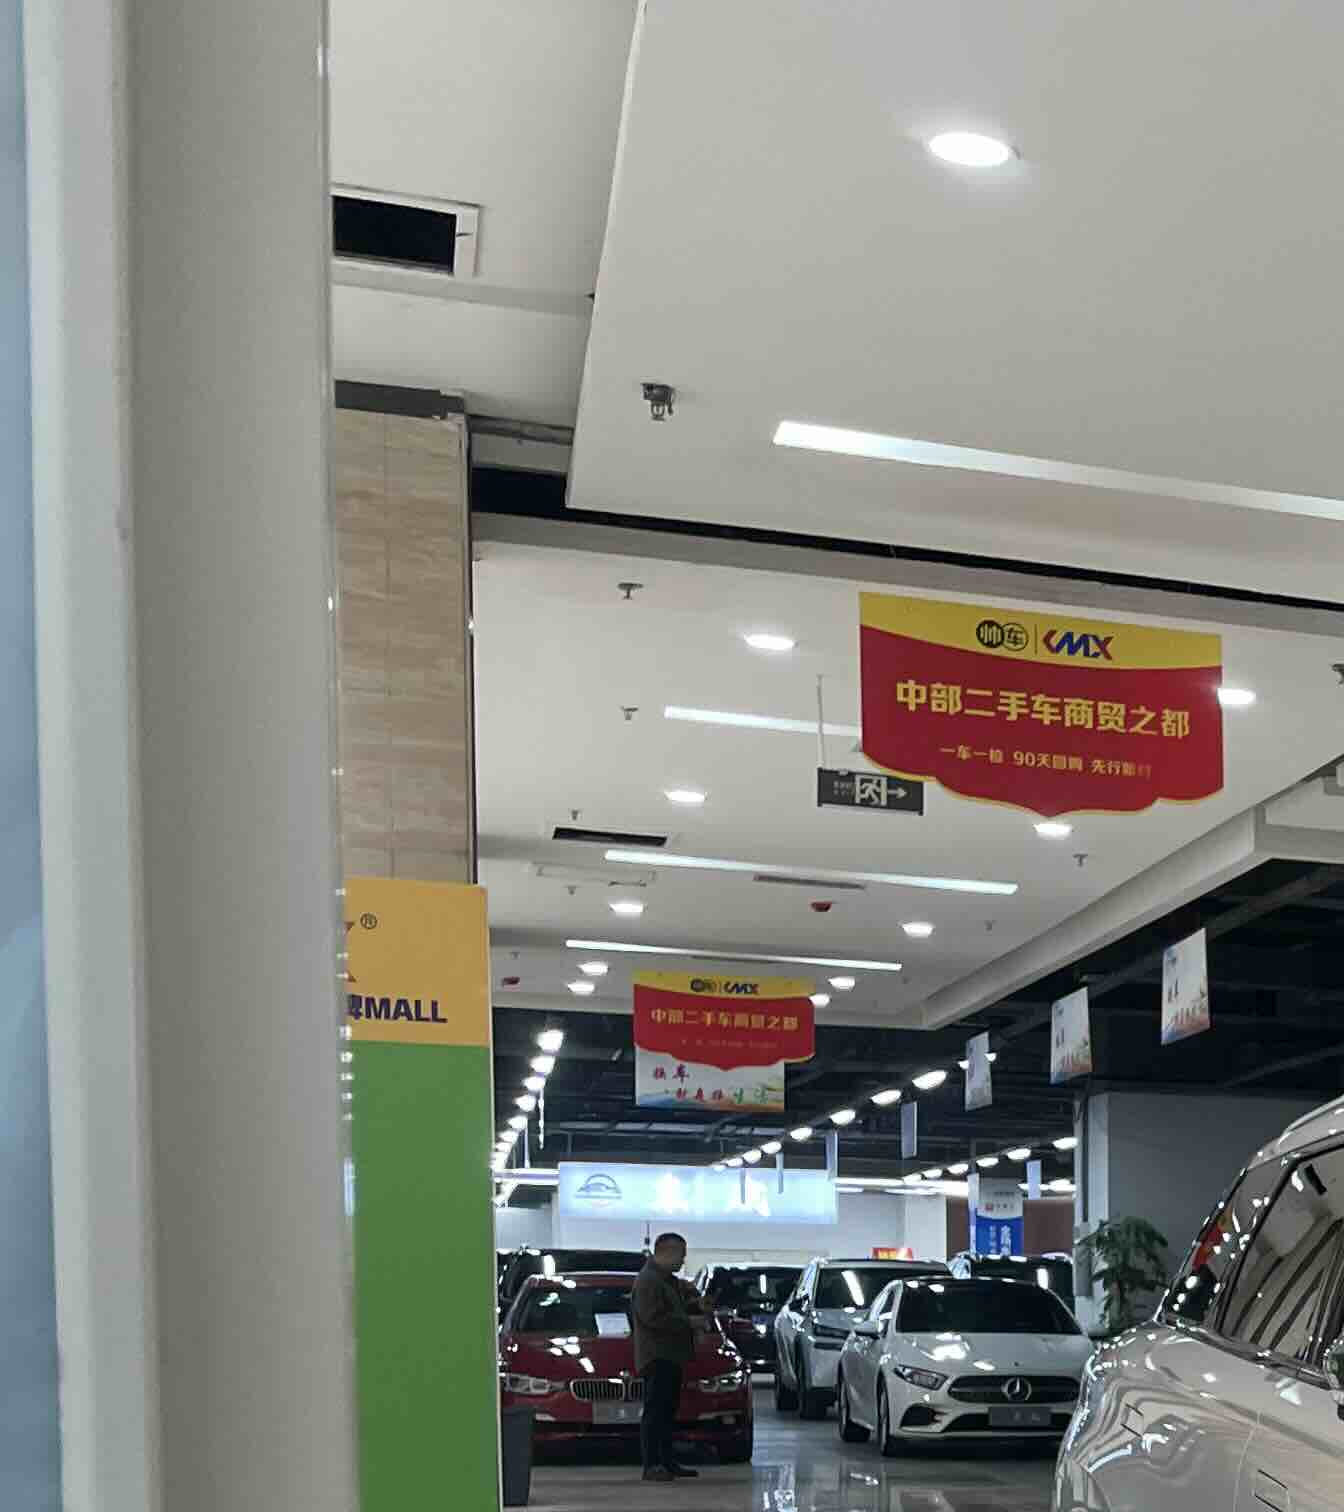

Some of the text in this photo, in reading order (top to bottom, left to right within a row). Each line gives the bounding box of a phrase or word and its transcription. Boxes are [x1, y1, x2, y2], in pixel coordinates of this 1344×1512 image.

[976, 620, 1029, 651] 帅车
[896, 679, 1190, 740] 中部二手车商贸之都
